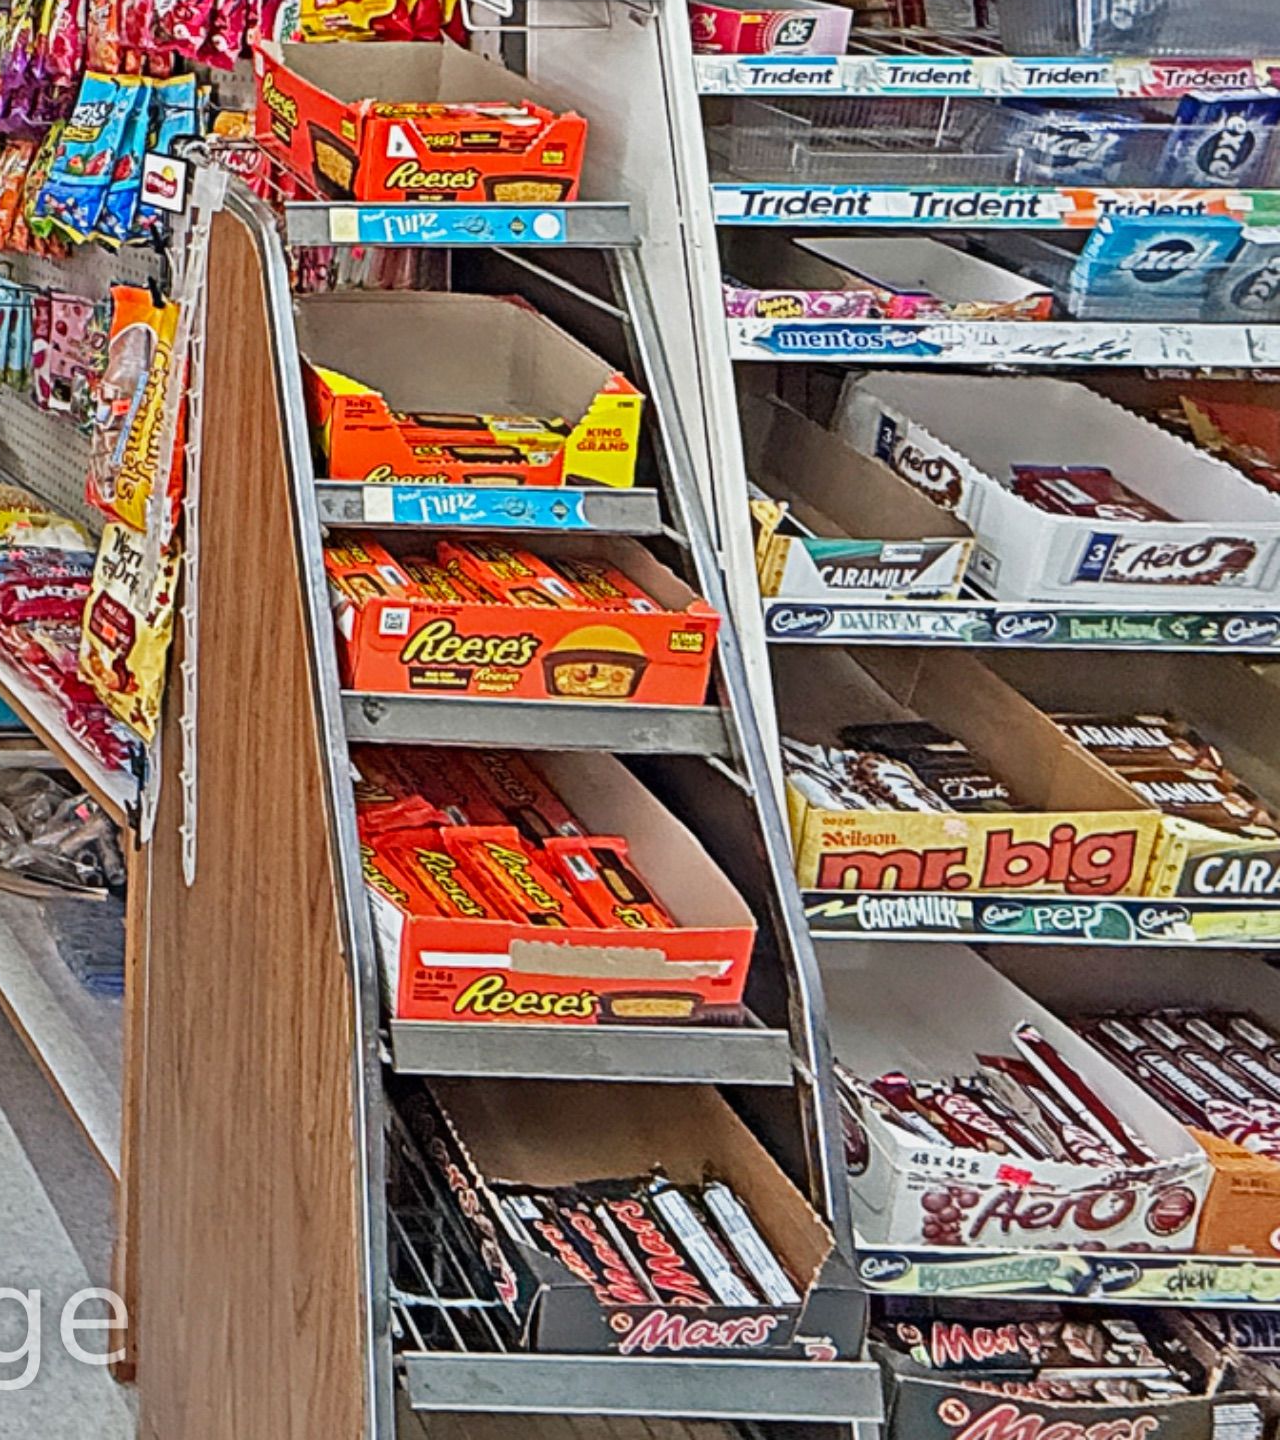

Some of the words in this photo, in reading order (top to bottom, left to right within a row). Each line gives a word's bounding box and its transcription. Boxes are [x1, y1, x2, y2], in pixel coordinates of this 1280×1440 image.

[749, 66, 834, 86] Trident
[886, 66, 973, 86] Trident
[1162, 69, 1249, 88] Trident
[385, 161, 481, 190] Reese's
[739, 188, 872, 218] Trident
[907, 190, 1041, 219] Trident
[1097, 198, 1207, 217] Trident
[383, 211, 439, 242] Flipz
[778, 326, 885, 349] mentos
[575, 440, 630, 453] GRAND
[585, 427, 624, 439] KING
[418, 490, 478, 522] Flipz
[1087, 544, 1105, 563] 3
[1127, 544, 1211, 575] Aero
[821, 566, 917, 589] CARAMILK
[838, 612, 897, 631] DAIRY
[400, 618, 540, 666] Reese's
[942, 782, 1010, 801] Dark
[821, 831, 899, 847] Neilson
[817, 846, 974, 891] mr.
[979, 822, 1139, 896] big
[856, 894, 962, 930] CARAMILK
[453, 973, 599, 1018] Reese's
[910, 1153, 930, 1166] 48
[946, 1156, 966, 1170] 42
[968, 1190, 1137, 1239] Aero
[618, 1309, 778, 1355] Mars
[931, 1322, 1040, 1365] Mars
